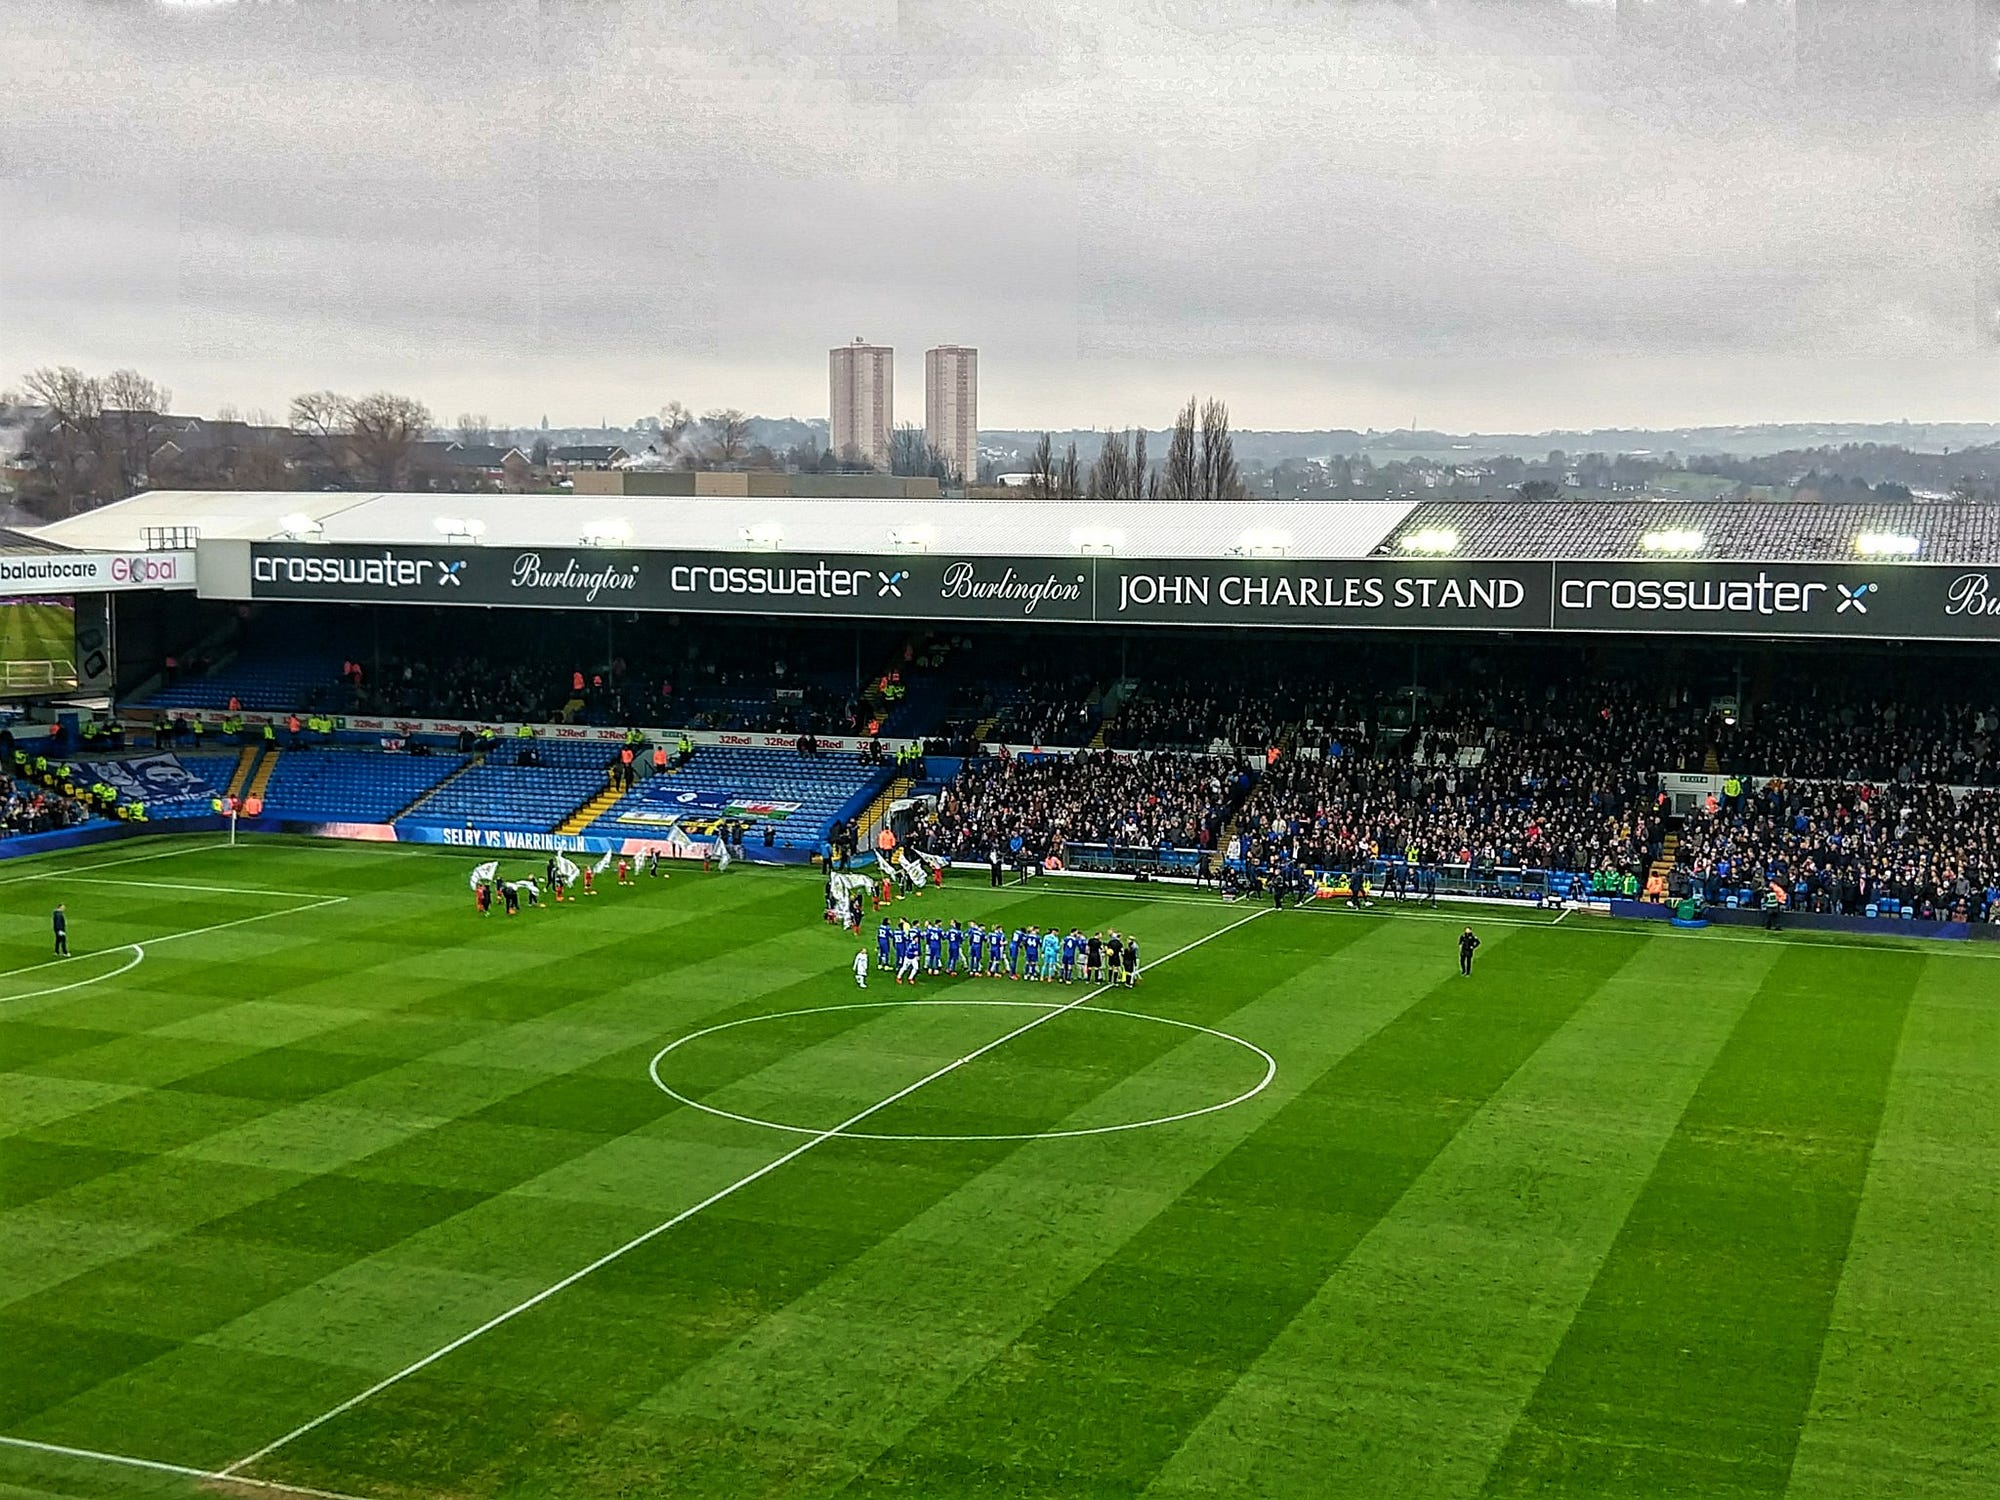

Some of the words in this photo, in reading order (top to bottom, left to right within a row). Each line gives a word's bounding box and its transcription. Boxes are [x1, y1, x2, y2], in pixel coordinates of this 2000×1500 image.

[111, 557, 177, 583] Global
[254, 552, 432, 588] crosswater
[511, 552, 636, 602] Burlington
[672, 561, 871, 597] crosswater
[942, 562, 1080, 614] Burlington
[1119, 576, 1209, 610] JOHN
[1219, 577, 1383, 607] CHARLES
[1394, 579, 1523, 608] STAND
[1562, 573, 1827, 614] crosswater
[815, 740, 844, 749] 2Red
[443, 828, 481, 846] SELBY
[484, 830, 501, 848] VS
